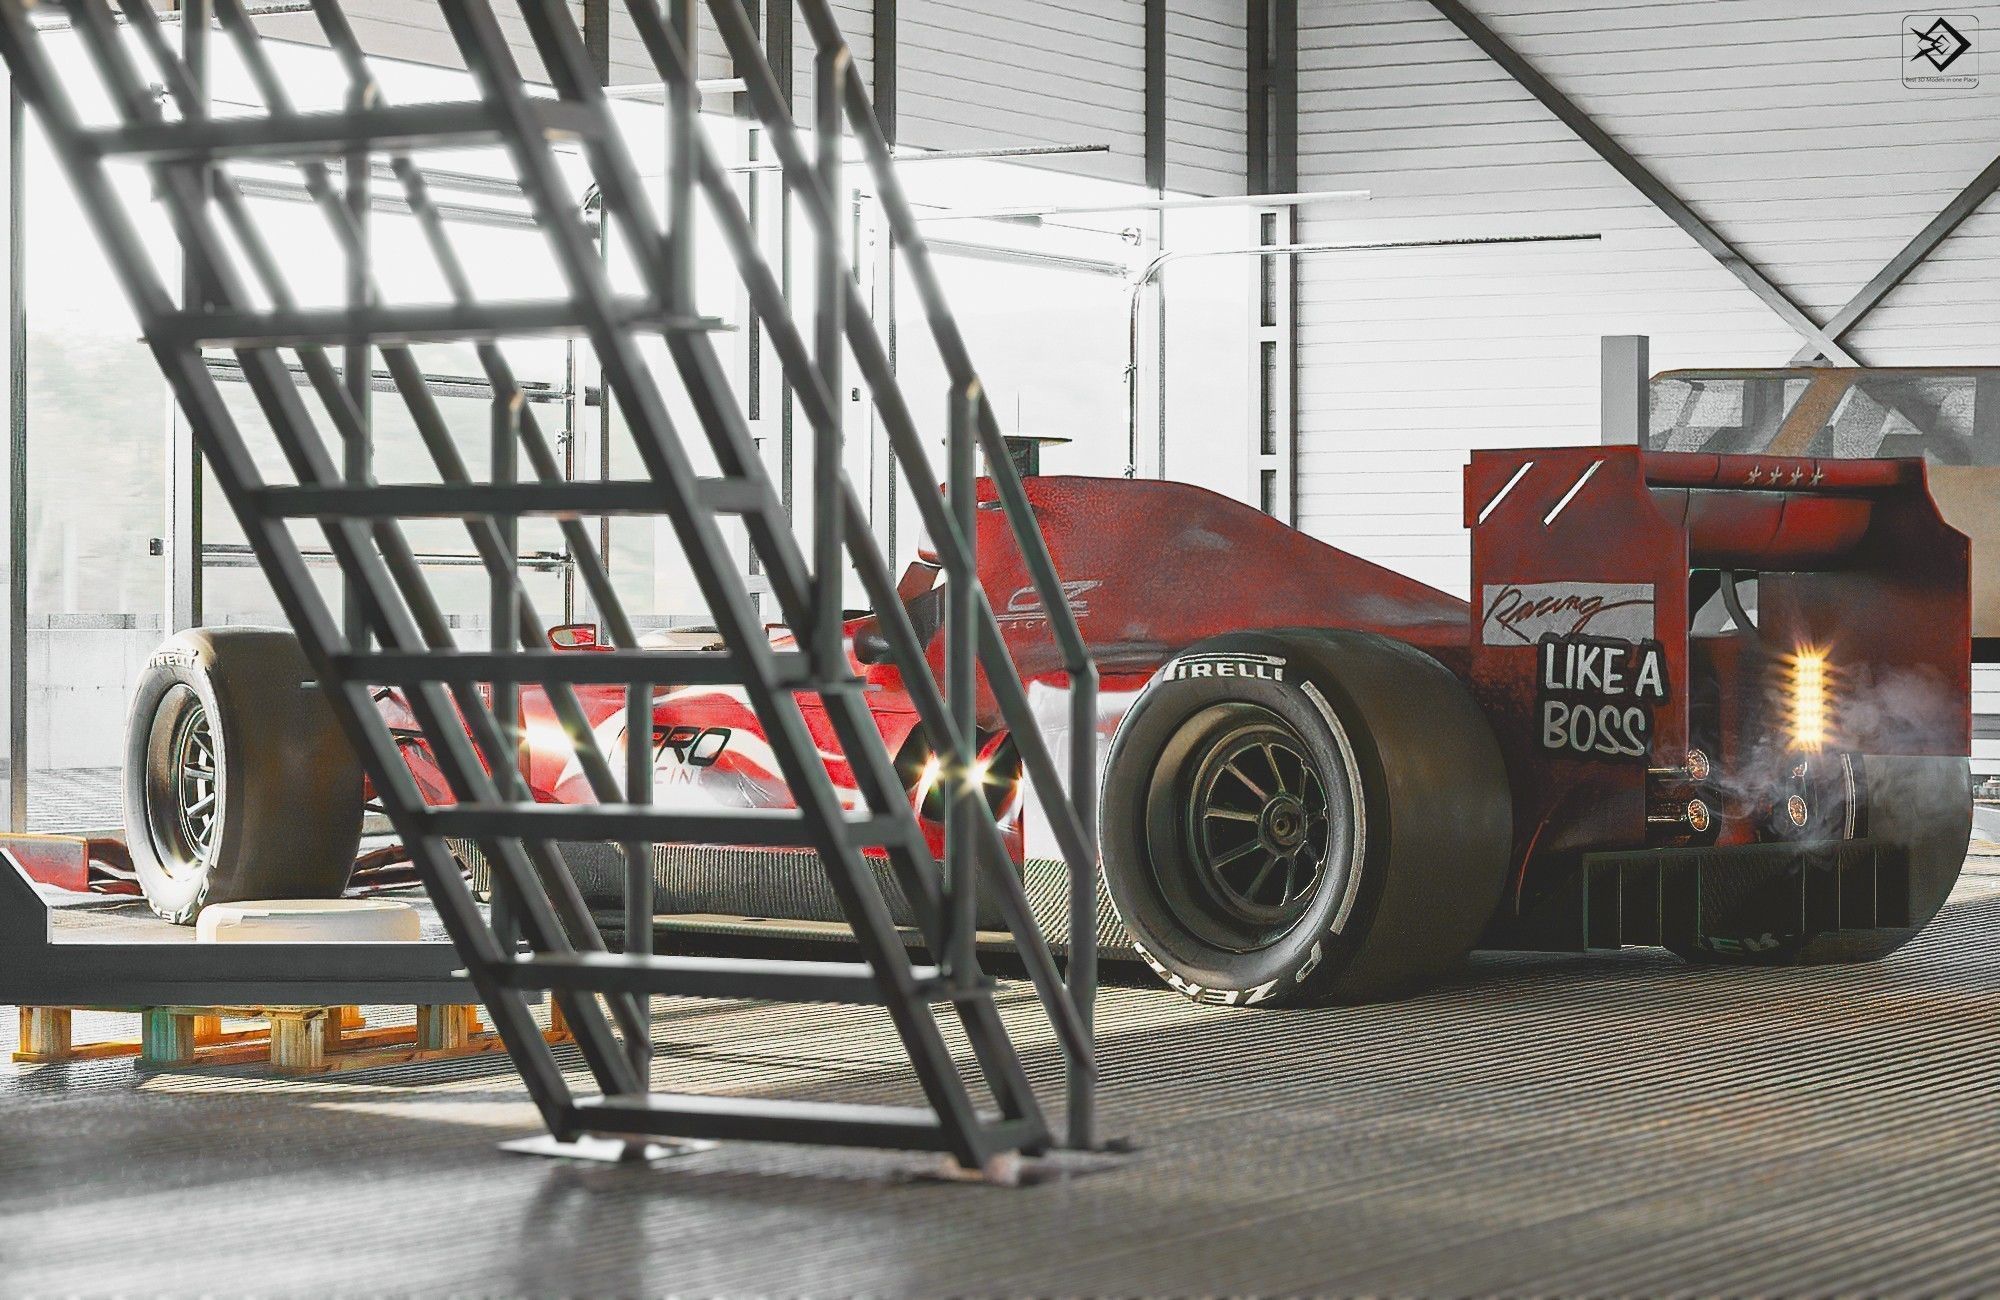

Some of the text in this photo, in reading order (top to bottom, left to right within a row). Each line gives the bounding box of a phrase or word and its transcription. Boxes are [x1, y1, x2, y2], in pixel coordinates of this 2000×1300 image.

[1162, 652, 1287, 682] PIRELLI
[1545, 643, 1663, 697] LIKE A
[1543, 700, 1646, 756] BOSS
[1132, 941, 1280, 1006] ZERO
